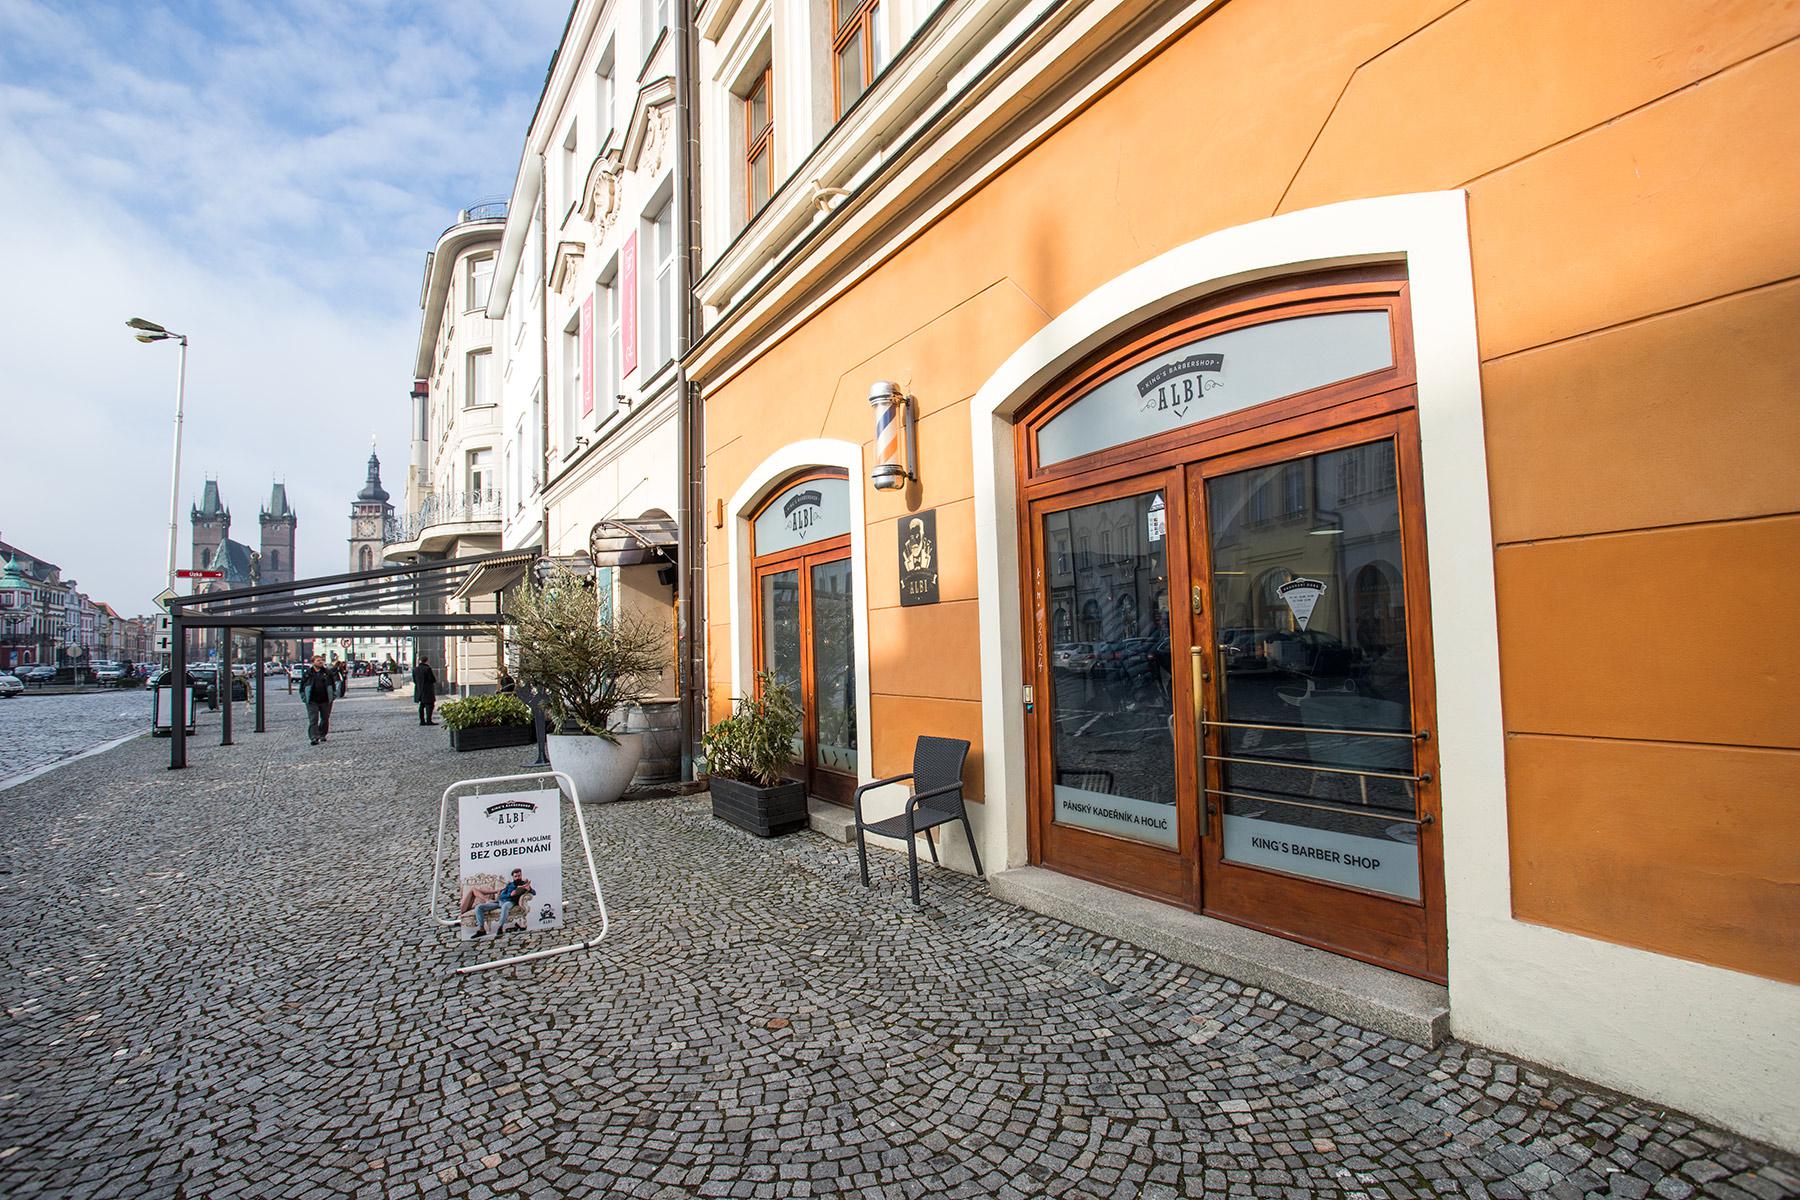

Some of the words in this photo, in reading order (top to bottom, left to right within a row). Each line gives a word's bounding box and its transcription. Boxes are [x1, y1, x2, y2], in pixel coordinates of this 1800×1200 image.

[1144, 370, 1167, 389] KING'S
[1168, 359, 1215, 373] BARBERSHOP
[1158, 374, 1204, 411] ALBI
[792, 507, 813, 531] ALBI
[909, 579, 928, 594] ALBI
[498, 811, 524, 825] ALBI
[1063, 800, 1092, 814] PÁNSKÝ
[1093, 806, 1133, 823] KADEŘNÍK
[1133, 815, 1140, 825] A
[1141, 817, 1168, 830] HOLIČ
[470, 850, 490, 860] BEZ
[493, 842, 551, 858] OBJEDNÁNÍ
[471, 841, 484, 849] ZDE
[485, 838, 519, 848] STŘÍHÁME
[527, 834, 551, 843] HOLÍME
[1292, 844, 1341, 863] BARBER
[1343, 854, 1381, 870] SHOP
